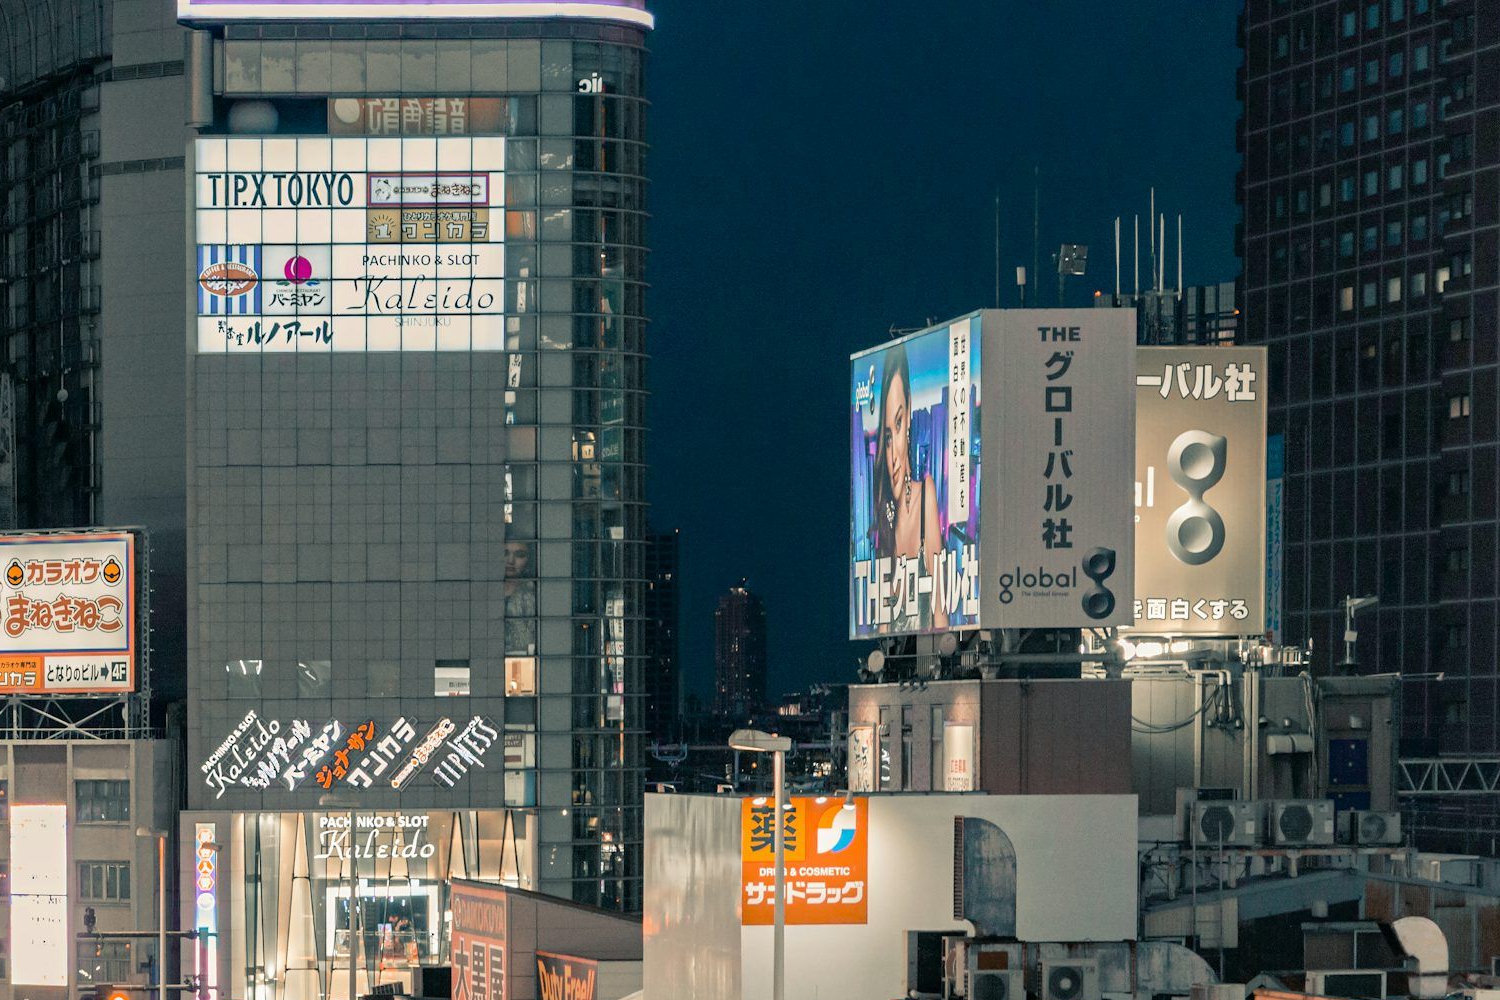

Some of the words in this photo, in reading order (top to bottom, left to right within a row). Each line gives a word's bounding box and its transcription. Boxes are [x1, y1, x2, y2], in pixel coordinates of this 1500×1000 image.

[207, 174, 267, 206] TIP.X
[272, 173, 353, 207] TOKYO
[430, 183, 481, 197] まねきねこ
[401, 222, 488, 239] ワンカラ
[402, 212, 477, 221] ひとりカラオケ専門店
[362, 254, 431, 266] PACHINKO
[434, 255, 443, 266] &
[447, 254, 480, 266] SLOT
[268, 293, 326, 307] バーミヤン
[347, 274, 494, 314] Kaleido
[246, 320, 334, 345] ルノアール
[394, 317, 451, 327] SHINJUKU
[1037, 326, 1081, 342] THE
[855, 380, 870, 412] global
[1136, 362, 1256, 402] ーバル社
[1042, 350, 1075, 549] グローバル社
[26, 559, 101, 586] カラオケ
[999, 566, 1076, 604] global
[5, 592, 123, 637] まねきねこ
[46, 664, 100, 682] となりのビル
[112, 662, 127, 682] 4F
[201, 734, 237, 774] PACHINKO
[239, 709, 257, 732] SLOT
[283, 719, 341, 792] バーミヤン
[315, 720, 375, 789] ジョナサン
[346, 716, 416, 789] ワンカラ
[433, 720, 498, 788] TIPNESS
[205, 719, 280, 800] Kaleido
[320, 816, 384, 828] PACHNKO
[386, 816, 396, 828] &
[399, 815, 430, 828] SLOT
[750, 805, 797, 853] 薬
[759, 867, 787, 876] DRG
[789, 867, 797, 876] &
[799, 867, 850, 876] COSMETIC
[745, 880, 864, 905] サンドラッグ
